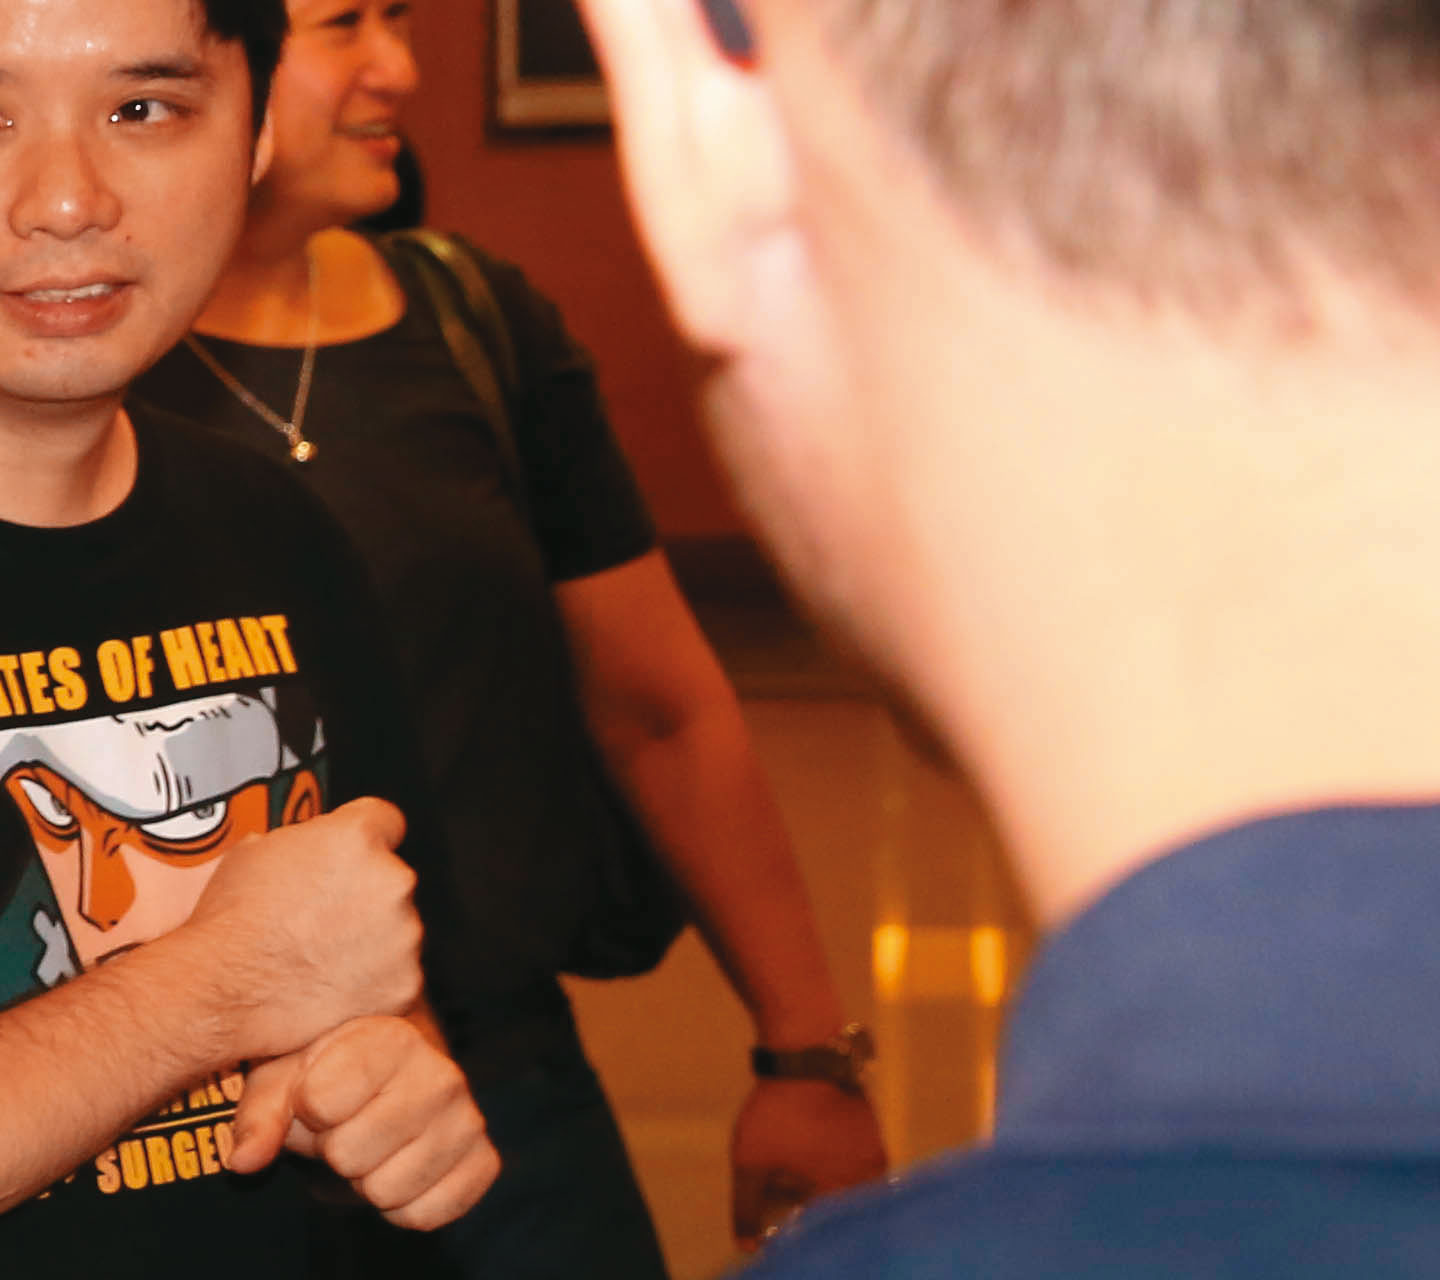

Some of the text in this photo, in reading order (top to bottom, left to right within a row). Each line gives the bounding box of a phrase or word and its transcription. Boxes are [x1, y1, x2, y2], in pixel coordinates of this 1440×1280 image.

[96, 634, 153, 704] OF
[159, 614, 298, 692] HEART
[95, 1120, 237, 1195] SURGEO
